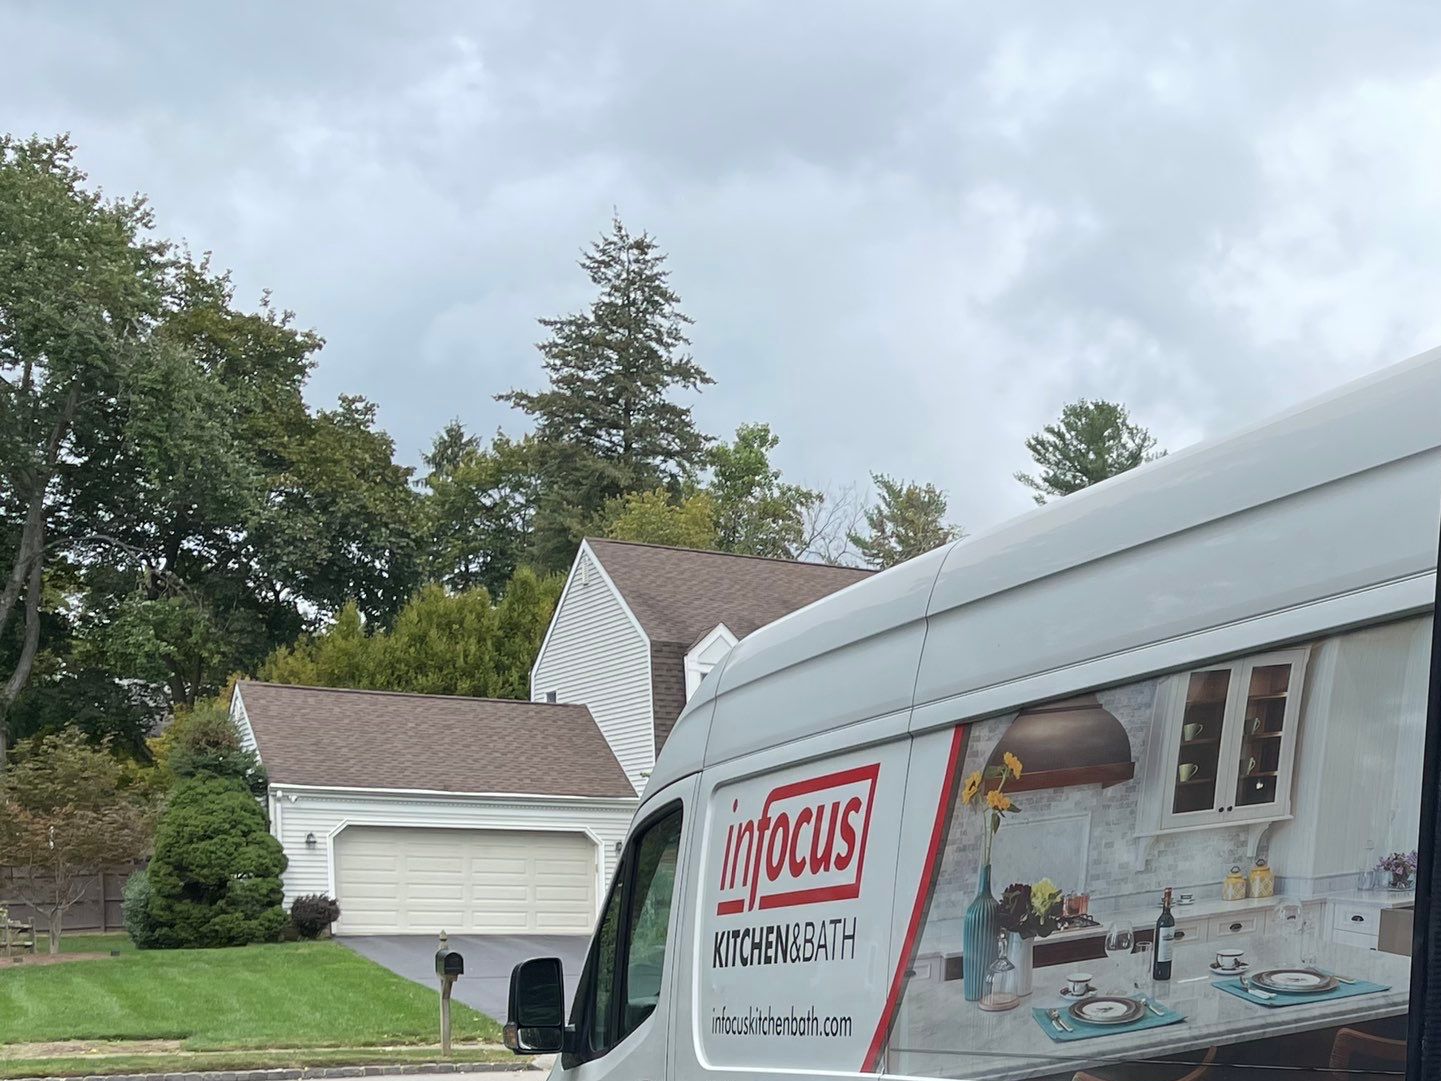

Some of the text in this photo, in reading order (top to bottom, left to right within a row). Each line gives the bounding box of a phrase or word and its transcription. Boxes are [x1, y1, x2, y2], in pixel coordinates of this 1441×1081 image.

[719, 784, 865, 912] infocus
[712, 917, 857, 969] KITCHEN&BATH
[711, 1006, 852, 1038] infocuskitchenbath.com
